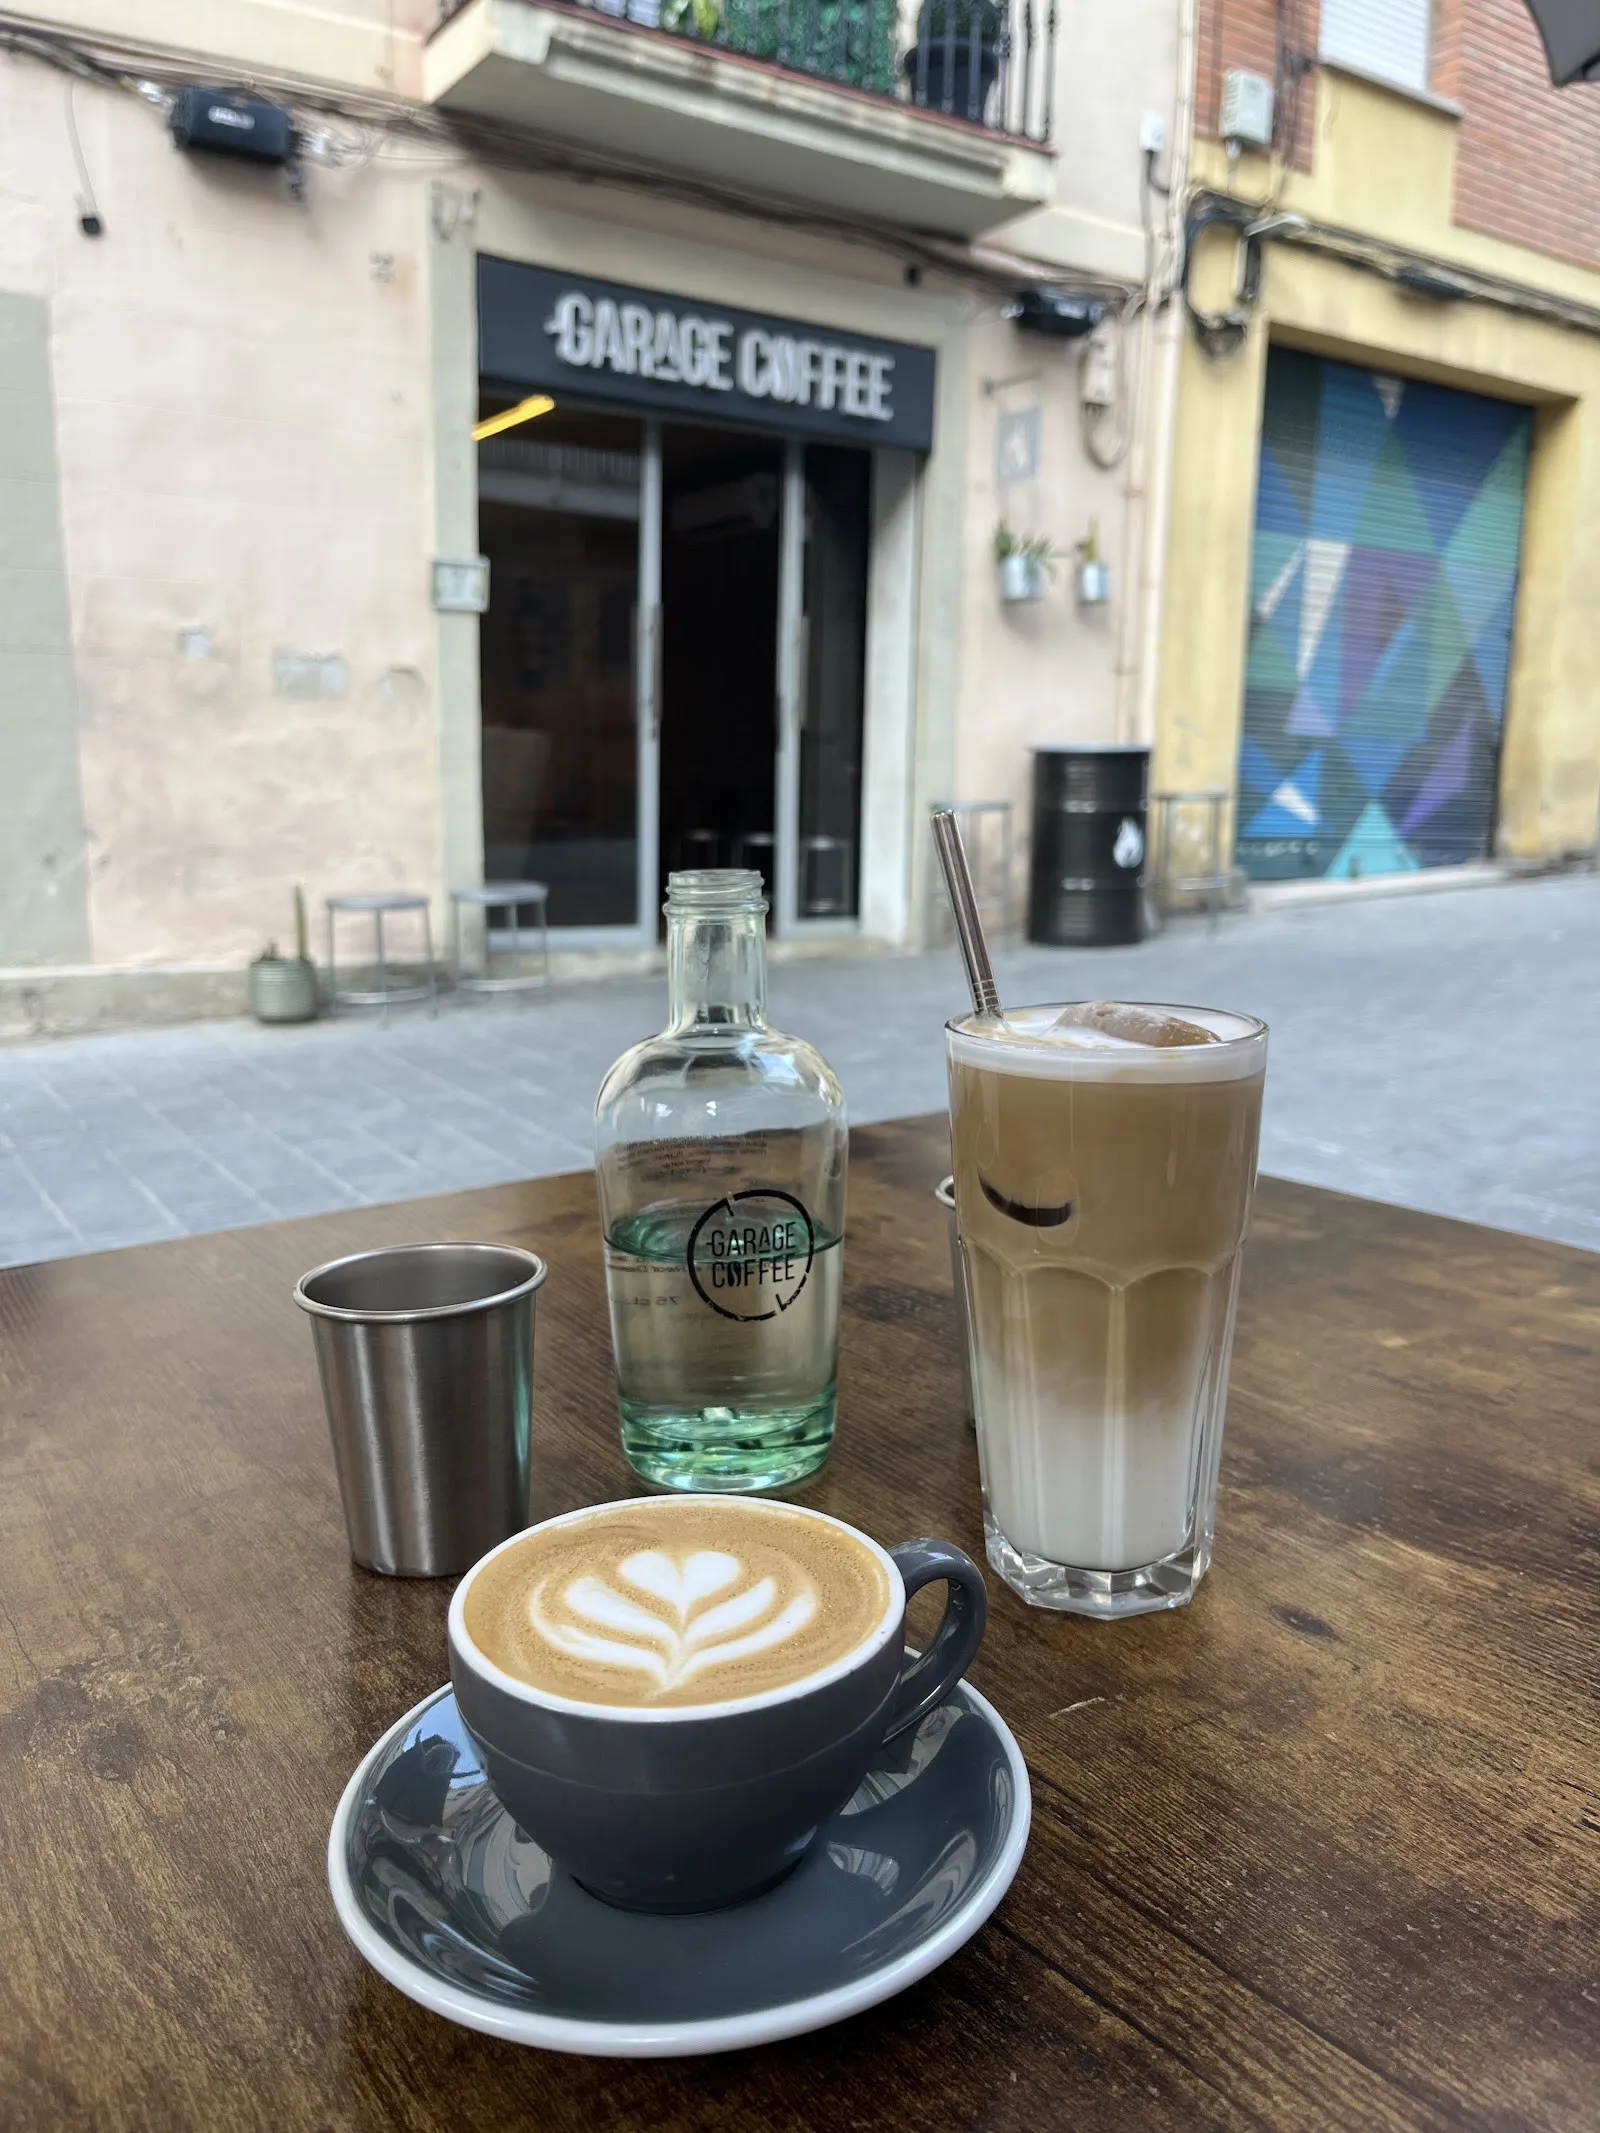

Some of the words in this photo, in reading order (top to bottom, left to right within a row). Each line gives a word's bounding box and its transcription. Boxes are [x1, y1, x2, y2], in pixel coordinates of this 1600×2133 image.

[544, 292, 734, 391] GARAGE
[737, 328, 896, 422] COFFEE
[707, 1222, 797, 1257] GARAGE
[712, 1252, 796, 1288] COFFEE
